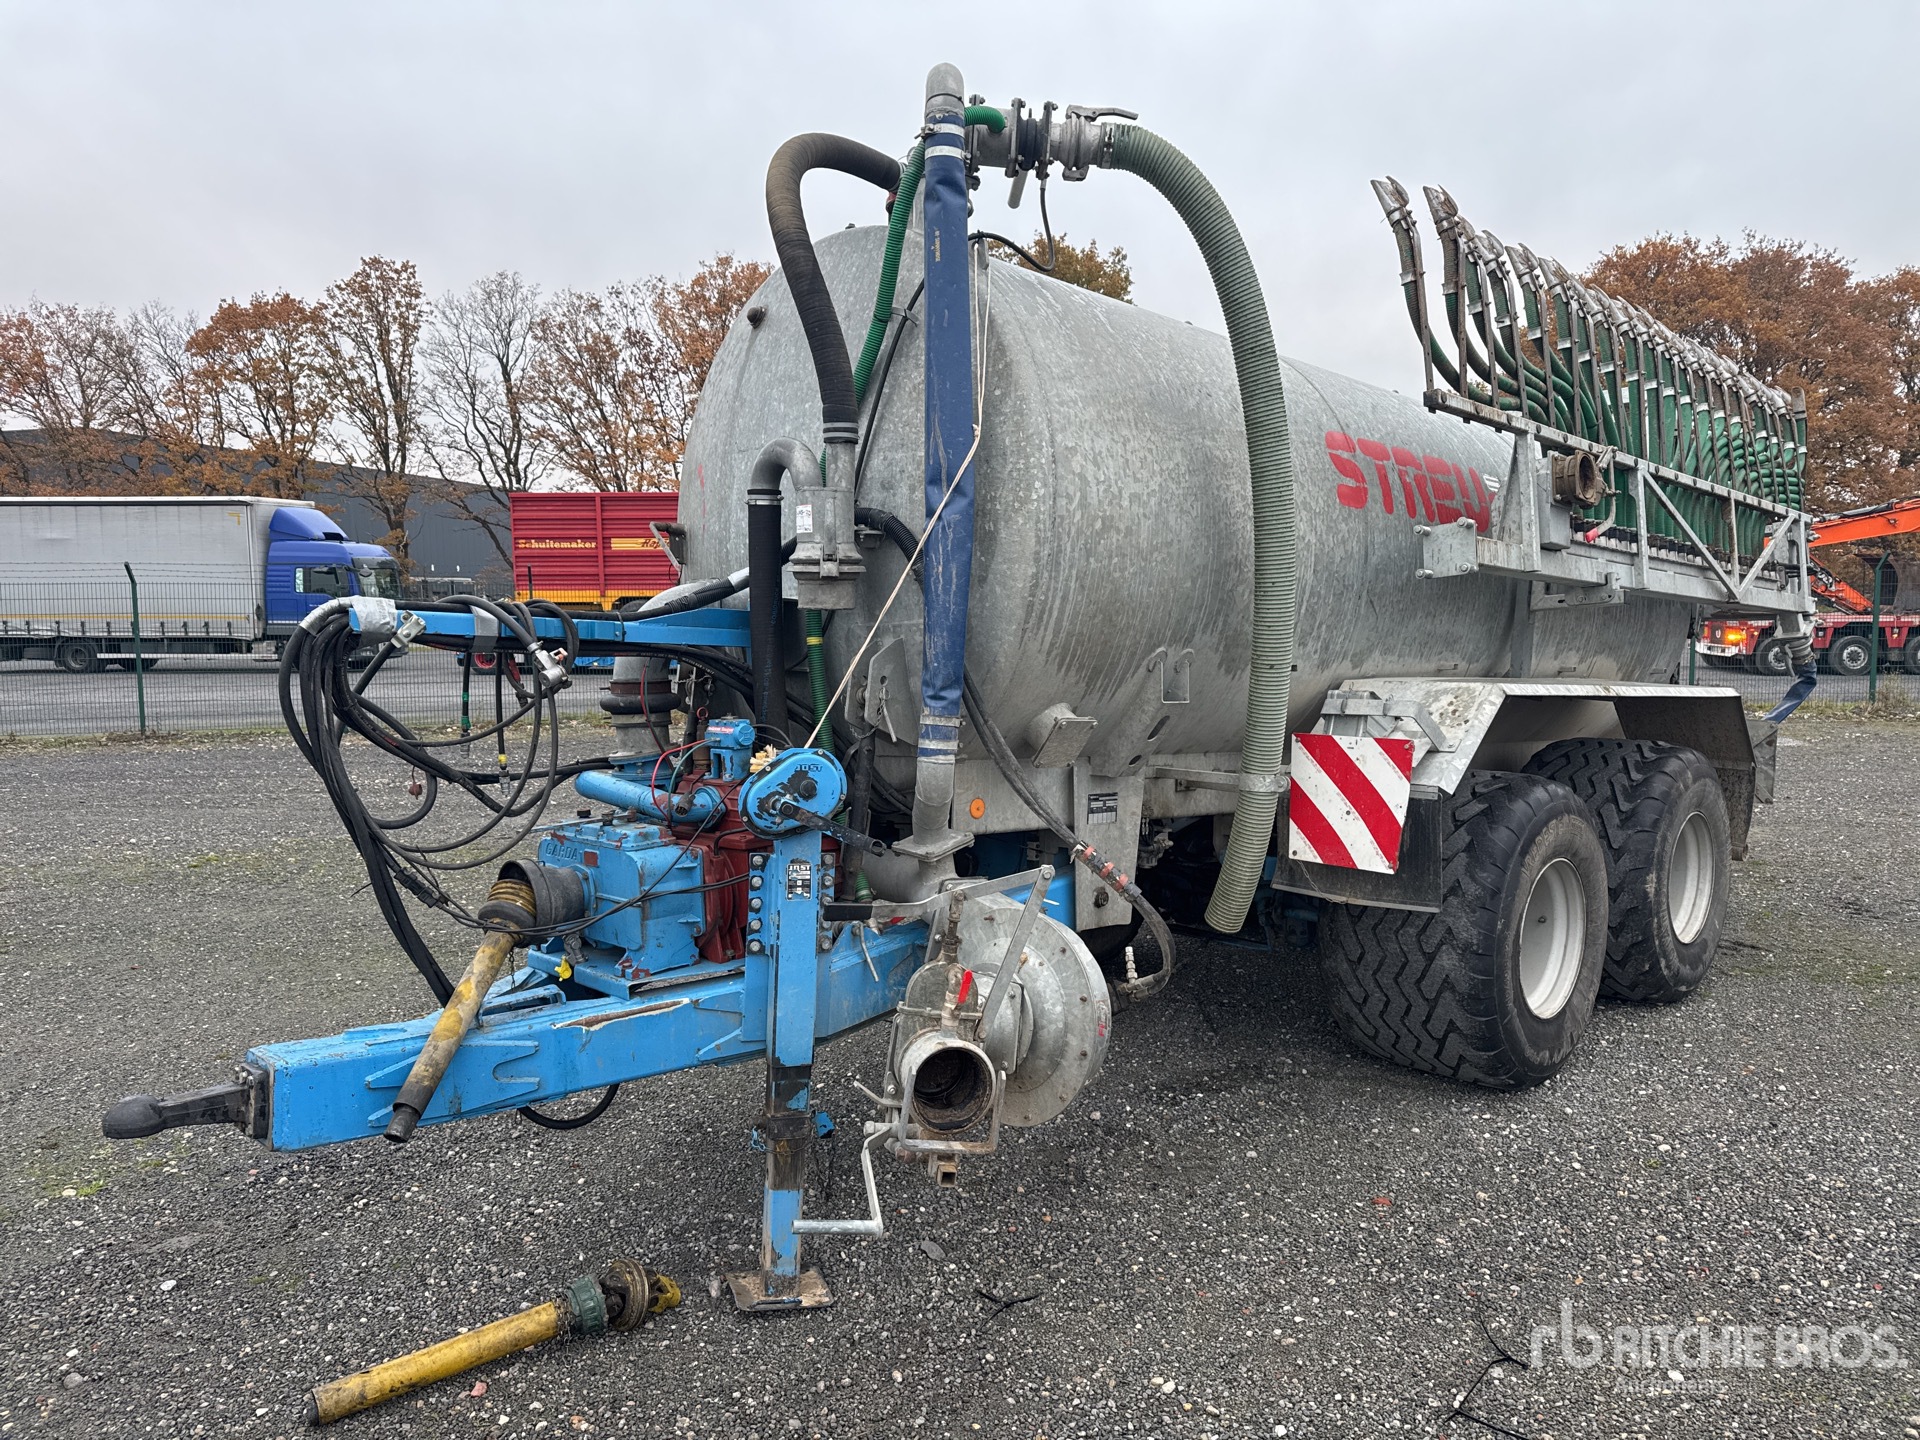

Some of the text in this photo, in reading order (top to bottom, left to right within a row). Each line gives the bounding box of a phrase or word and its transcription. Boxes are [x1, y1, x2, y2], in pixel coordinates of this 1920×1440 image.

[1325, 430, 1497, 533] STREU
[518, 539, 596, 549] Schuitemaker
[795, 764, 823, 773] JOST
[546, 843, 578, 861] GARDA
